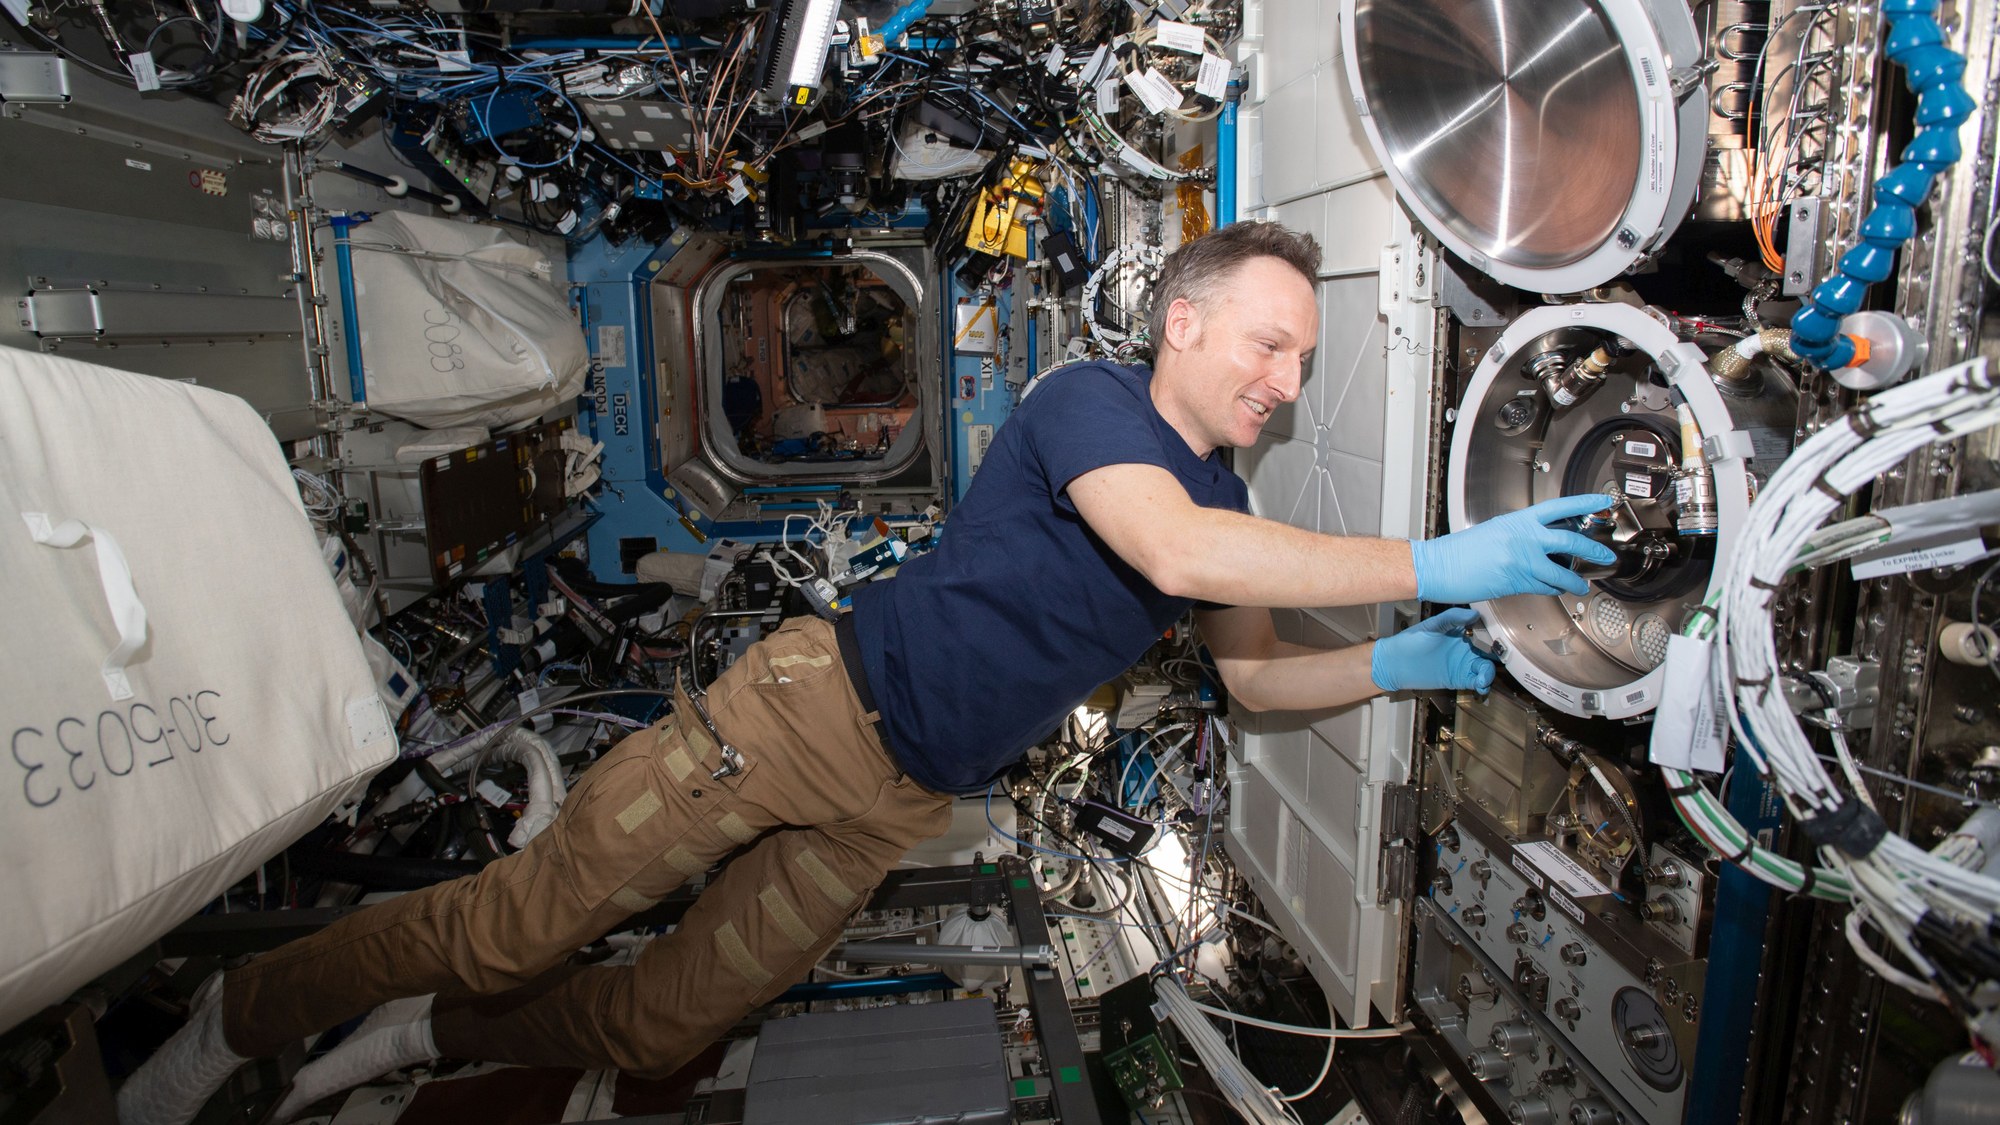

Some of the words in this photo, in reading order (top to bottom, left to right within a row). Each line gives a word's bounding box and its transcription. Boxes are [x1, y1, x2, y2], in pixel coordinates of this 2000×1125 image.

[613, 395, 627, 435] DECK
[1893, 554, 1929, 565] EXPRESS
[1930, 549, 1956, 559] Locker
[1905, 562, 1923, 571] Data
